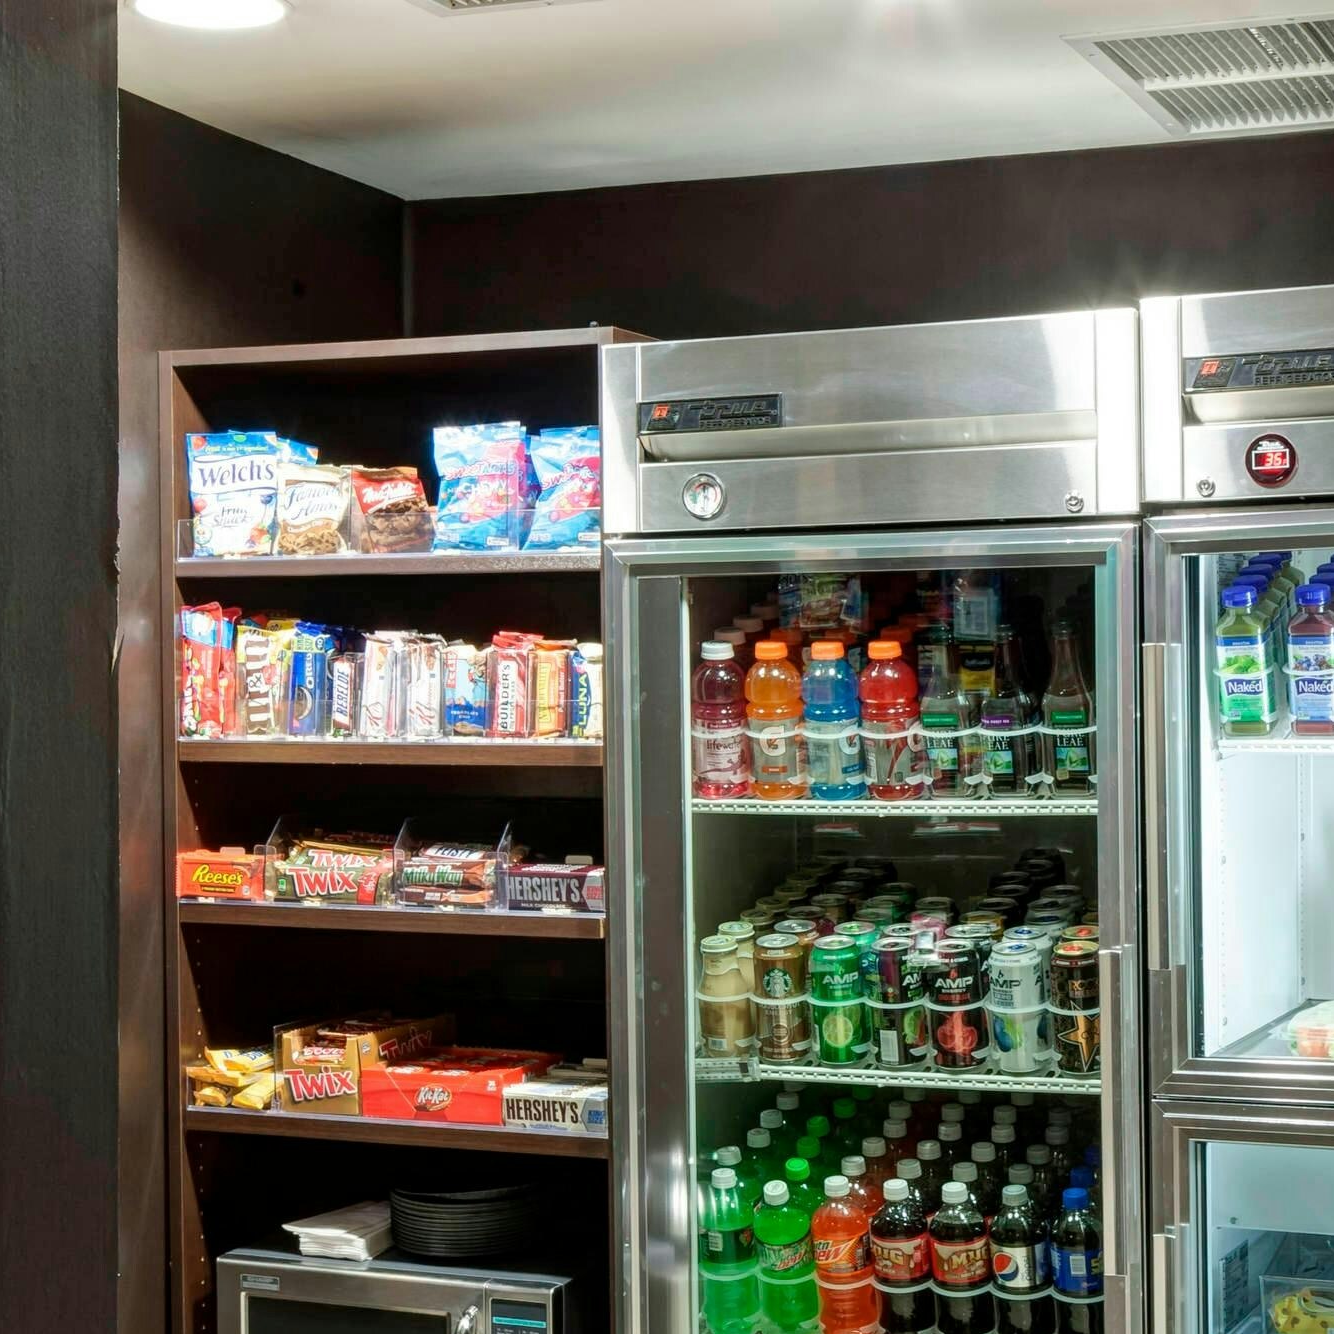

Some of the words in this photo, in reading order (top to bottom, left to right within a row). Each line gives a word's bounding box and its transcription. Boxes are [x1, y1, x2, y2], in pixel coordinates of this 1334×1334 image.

[198, 459, 274, 487] Welch's
[500, 664, 511, 730] BUILDER'S
[578, 673, 588, 726] LUNA
[988, 740, 1009, 751] EAF
[402, 865, 434, 885] Milky
[434, 864, 464, 886] Way
[507, 876, 580, 903] HERSHEY'S
[822, 971, 858, 985] AMP
[935, 976, 974, 988] AMP
[505, 1098, 579, 1124] HERSHEY'S
